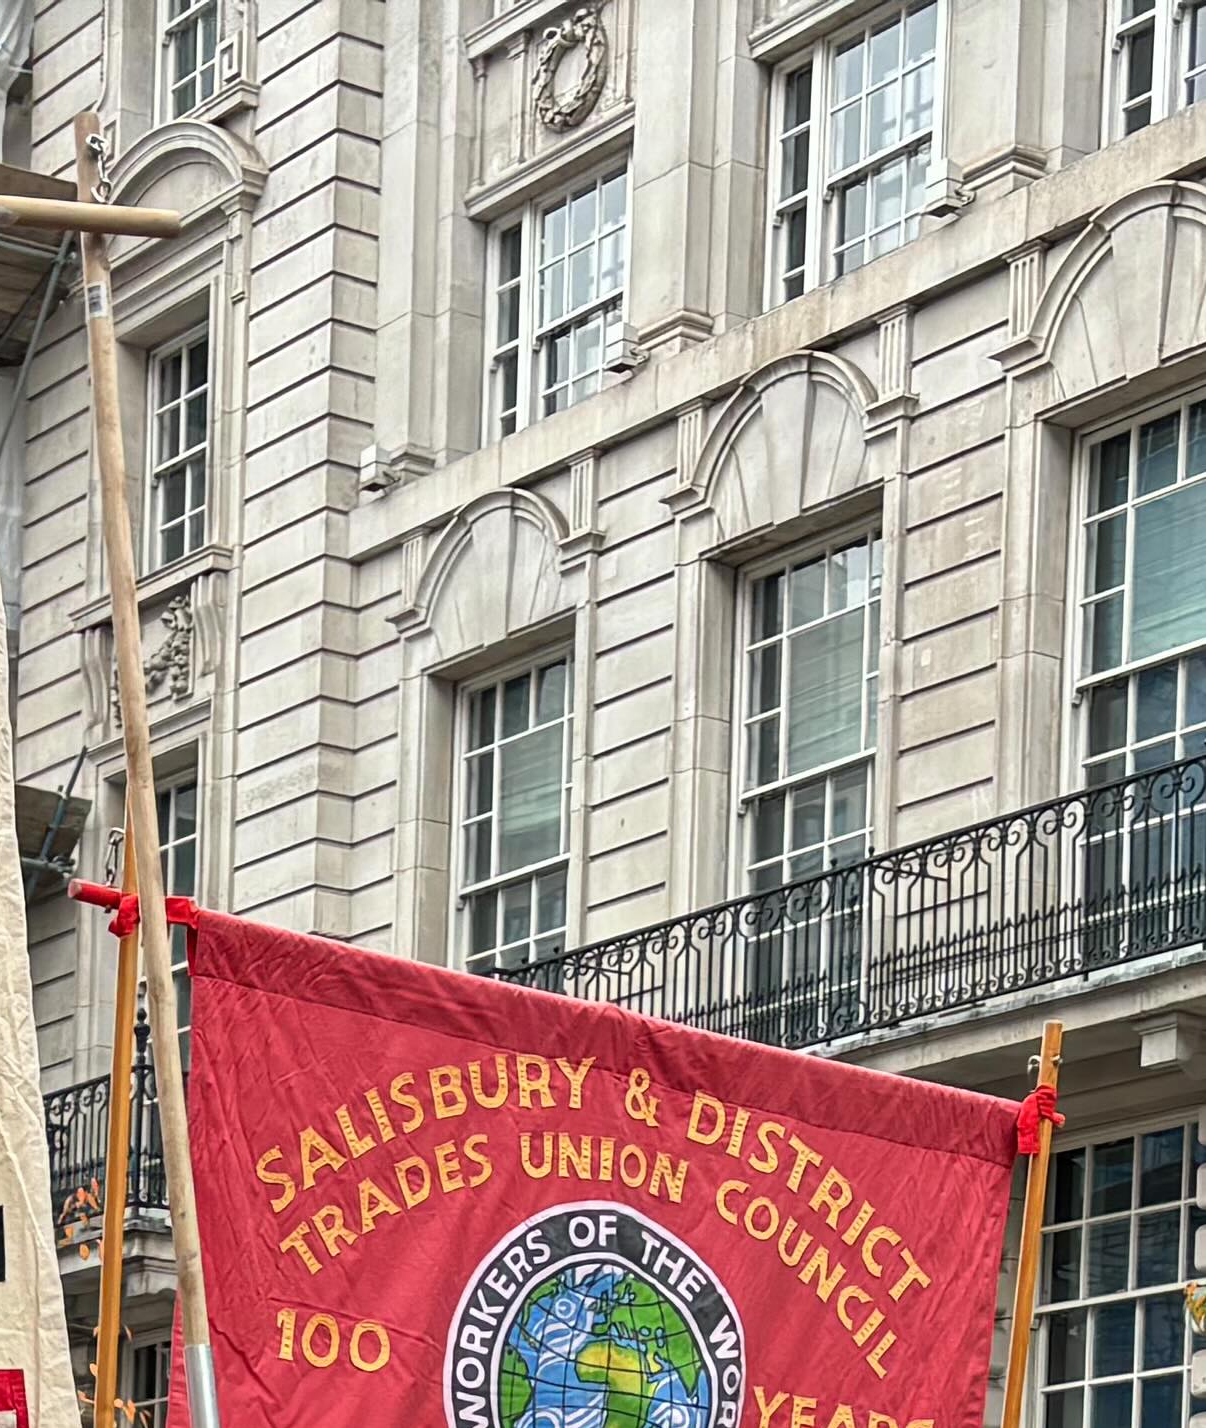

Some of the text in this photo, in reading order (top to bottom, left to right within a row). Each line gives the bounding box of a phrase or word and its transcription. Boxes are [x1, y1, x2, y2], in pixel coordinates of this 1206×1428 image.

[255, 1053, 932, 1303] SALISBURY & DISTRICT
[279, 1131, 897, 1380] TRADES UNION COUNCIL
[568, 1215, 618, 1249] OF
[639, 1234, 707, 1302] THE
[277, 1307, 391, 1372] 100
